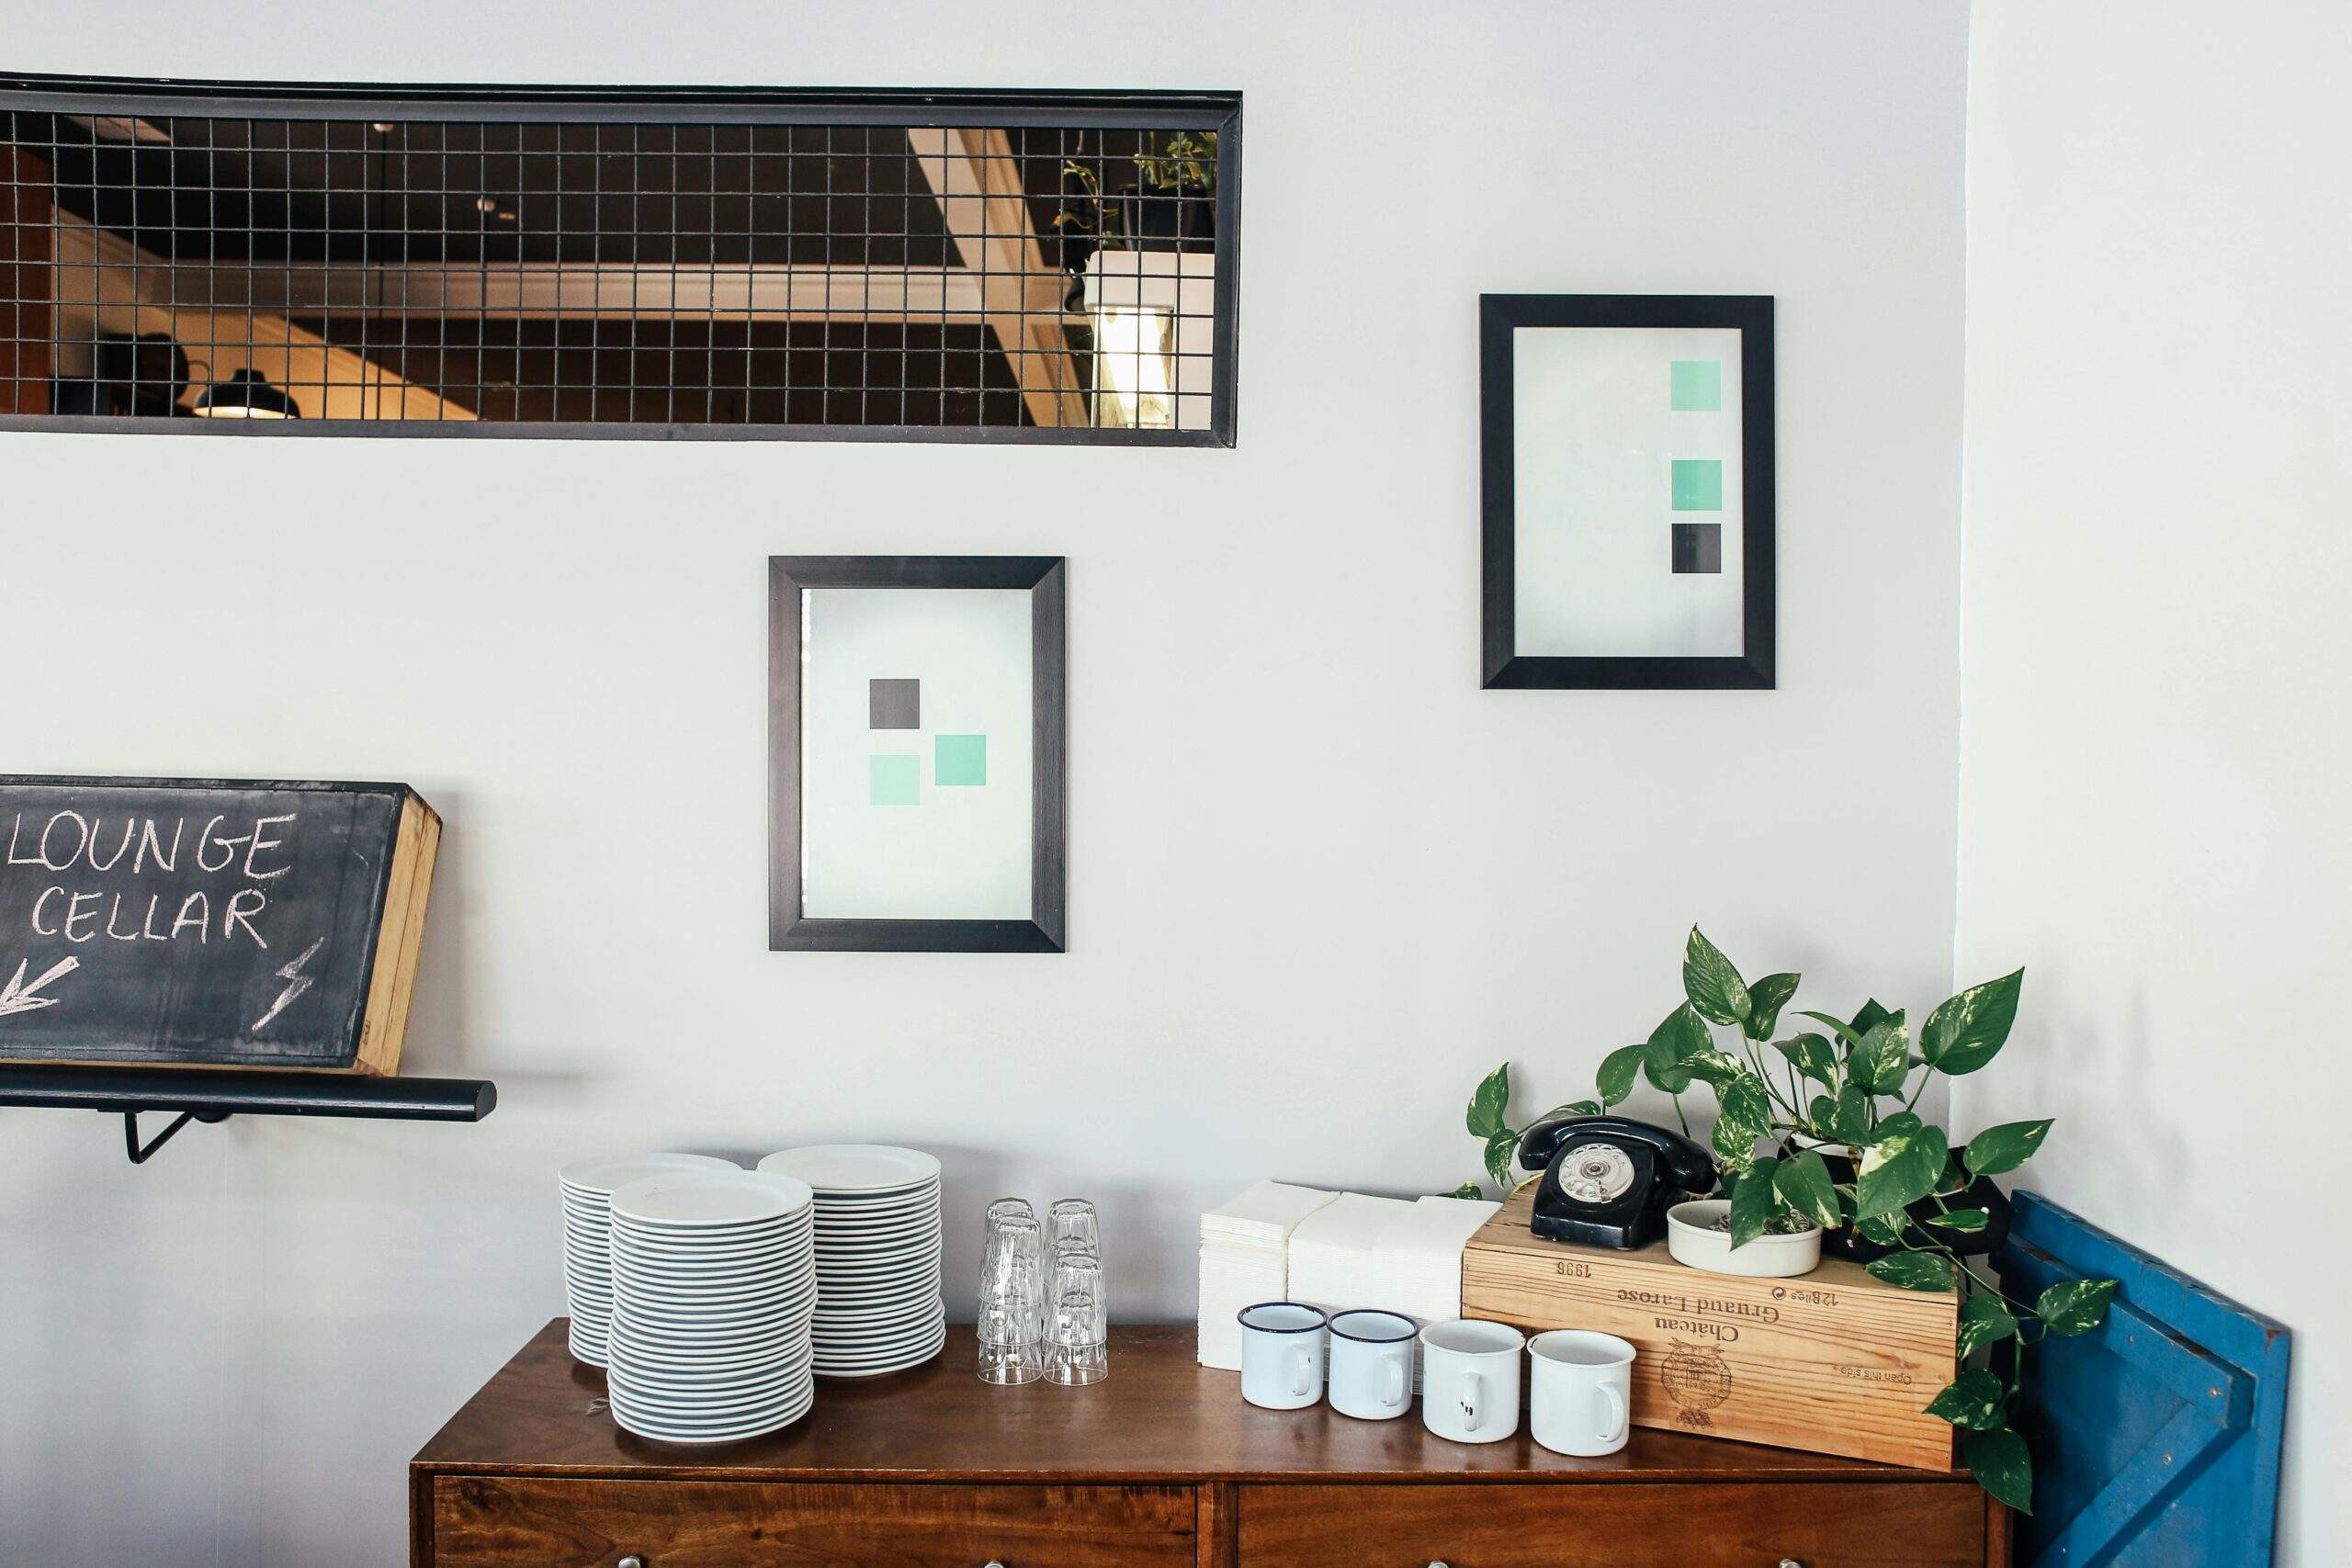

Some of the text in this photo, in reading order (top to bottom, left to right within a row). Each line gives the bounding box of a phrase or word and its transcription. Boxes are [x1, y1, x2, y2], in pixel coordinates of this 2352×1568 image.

[8, 810, 298, 880] LOUNGE
[31, 886, 267, 949] CELLAR
[1617, 1289, 1780, 1324] Gruaud Larose
[1823, 1292, 1839, 1307] 12
[1655, 1316, 1739, 1342] Château
[1840, 1366, 1911, 1385] Open this side
